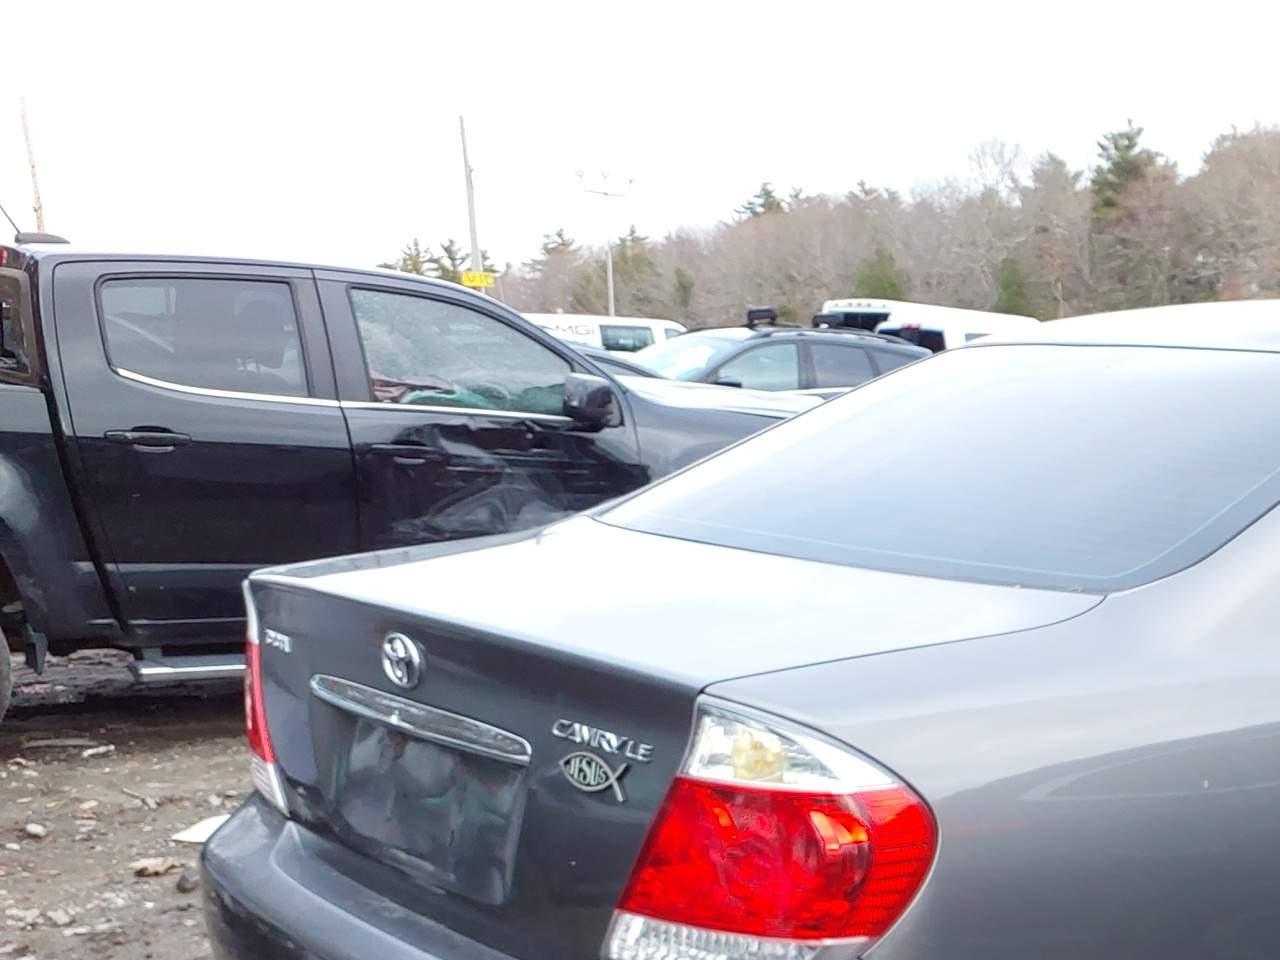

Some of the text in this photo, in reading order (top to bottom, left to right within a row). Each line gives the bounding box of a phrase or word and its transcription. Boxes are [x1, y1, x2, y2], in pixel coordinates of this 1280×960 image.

[552, 718, 656, 763] CAMRY LE
[567, 756, 607, 786] JESUS
